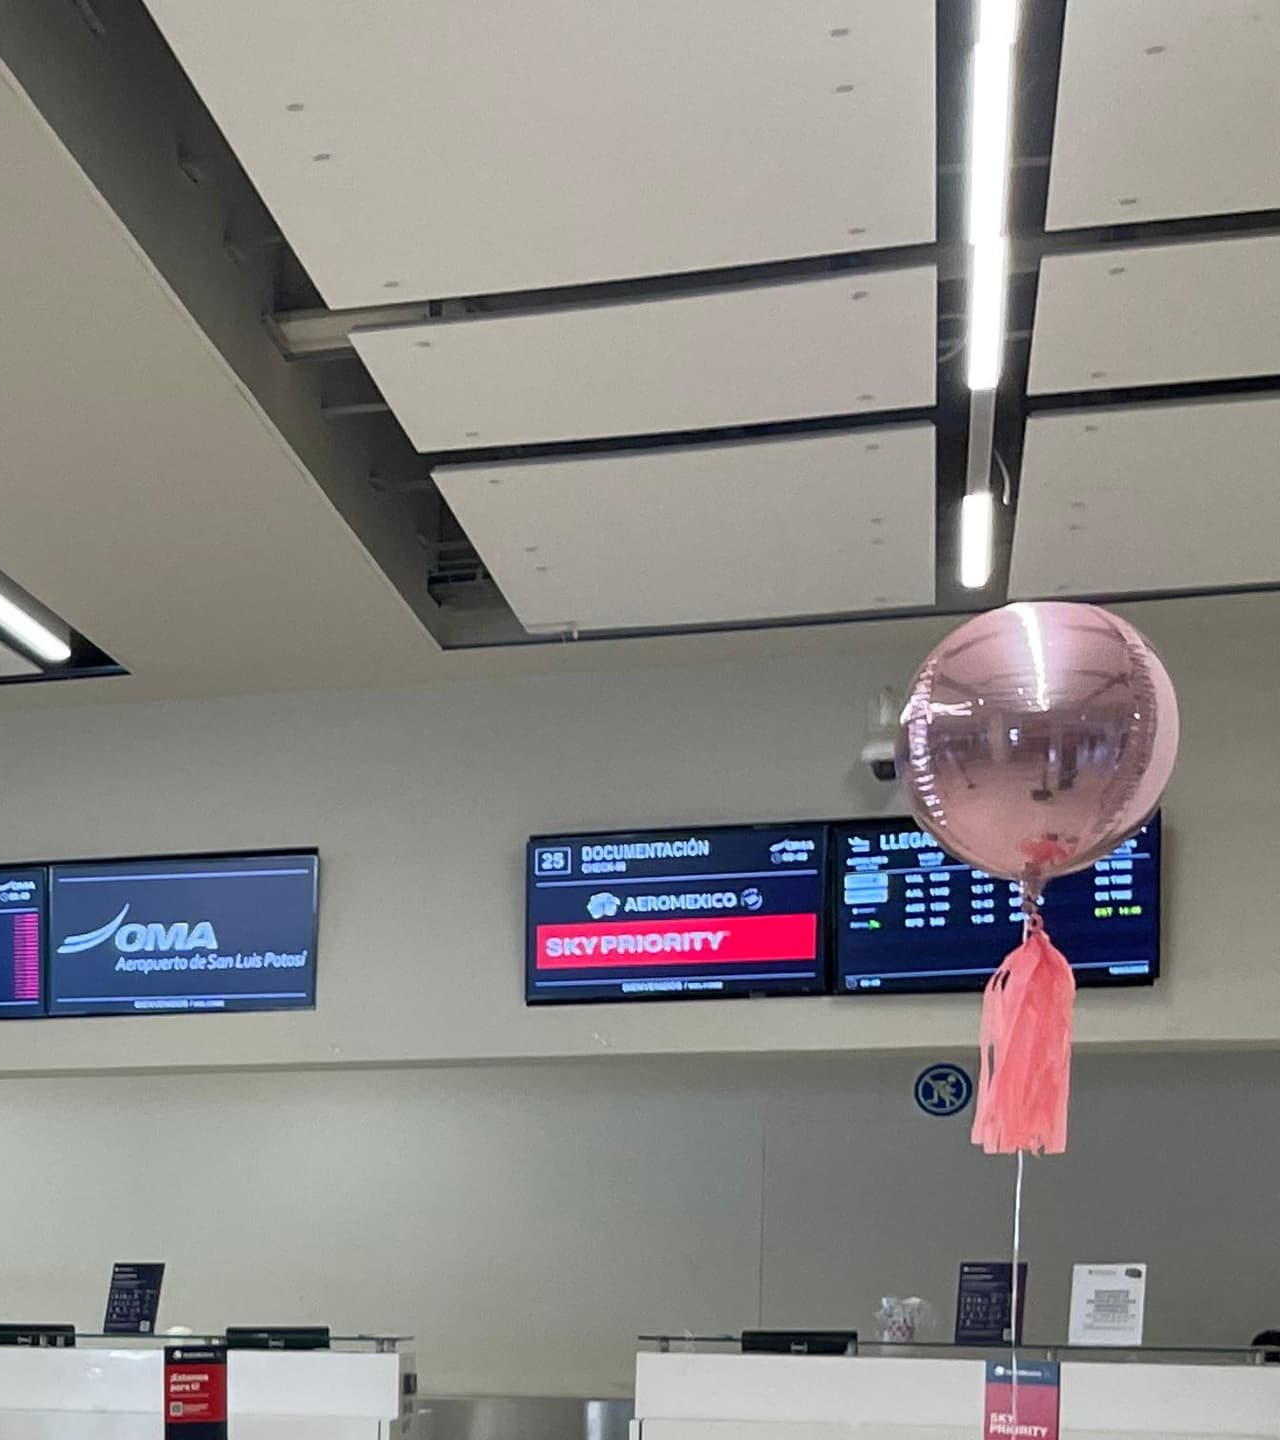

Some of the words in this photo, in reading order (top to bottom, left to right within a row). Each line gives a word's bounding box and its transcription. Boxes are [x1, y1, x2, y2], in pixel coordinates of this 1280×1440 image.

[880, 832, 938, 850] LLEGA
[541, 852, 565, 870] 25
[581, 838, 709, 862] DOCUMENTACIÓN
[624, 892, 738, 912] AEROMEXICO
[115, 921, 218, 952] OMA
[115, 956, 188, 974] Aeropuerto
[190, 954, 206, 969] de
[207, 954, 233, 969] San
[236, 953, 262, 968] Luis
[264, 950, 308, 967] Potosí
